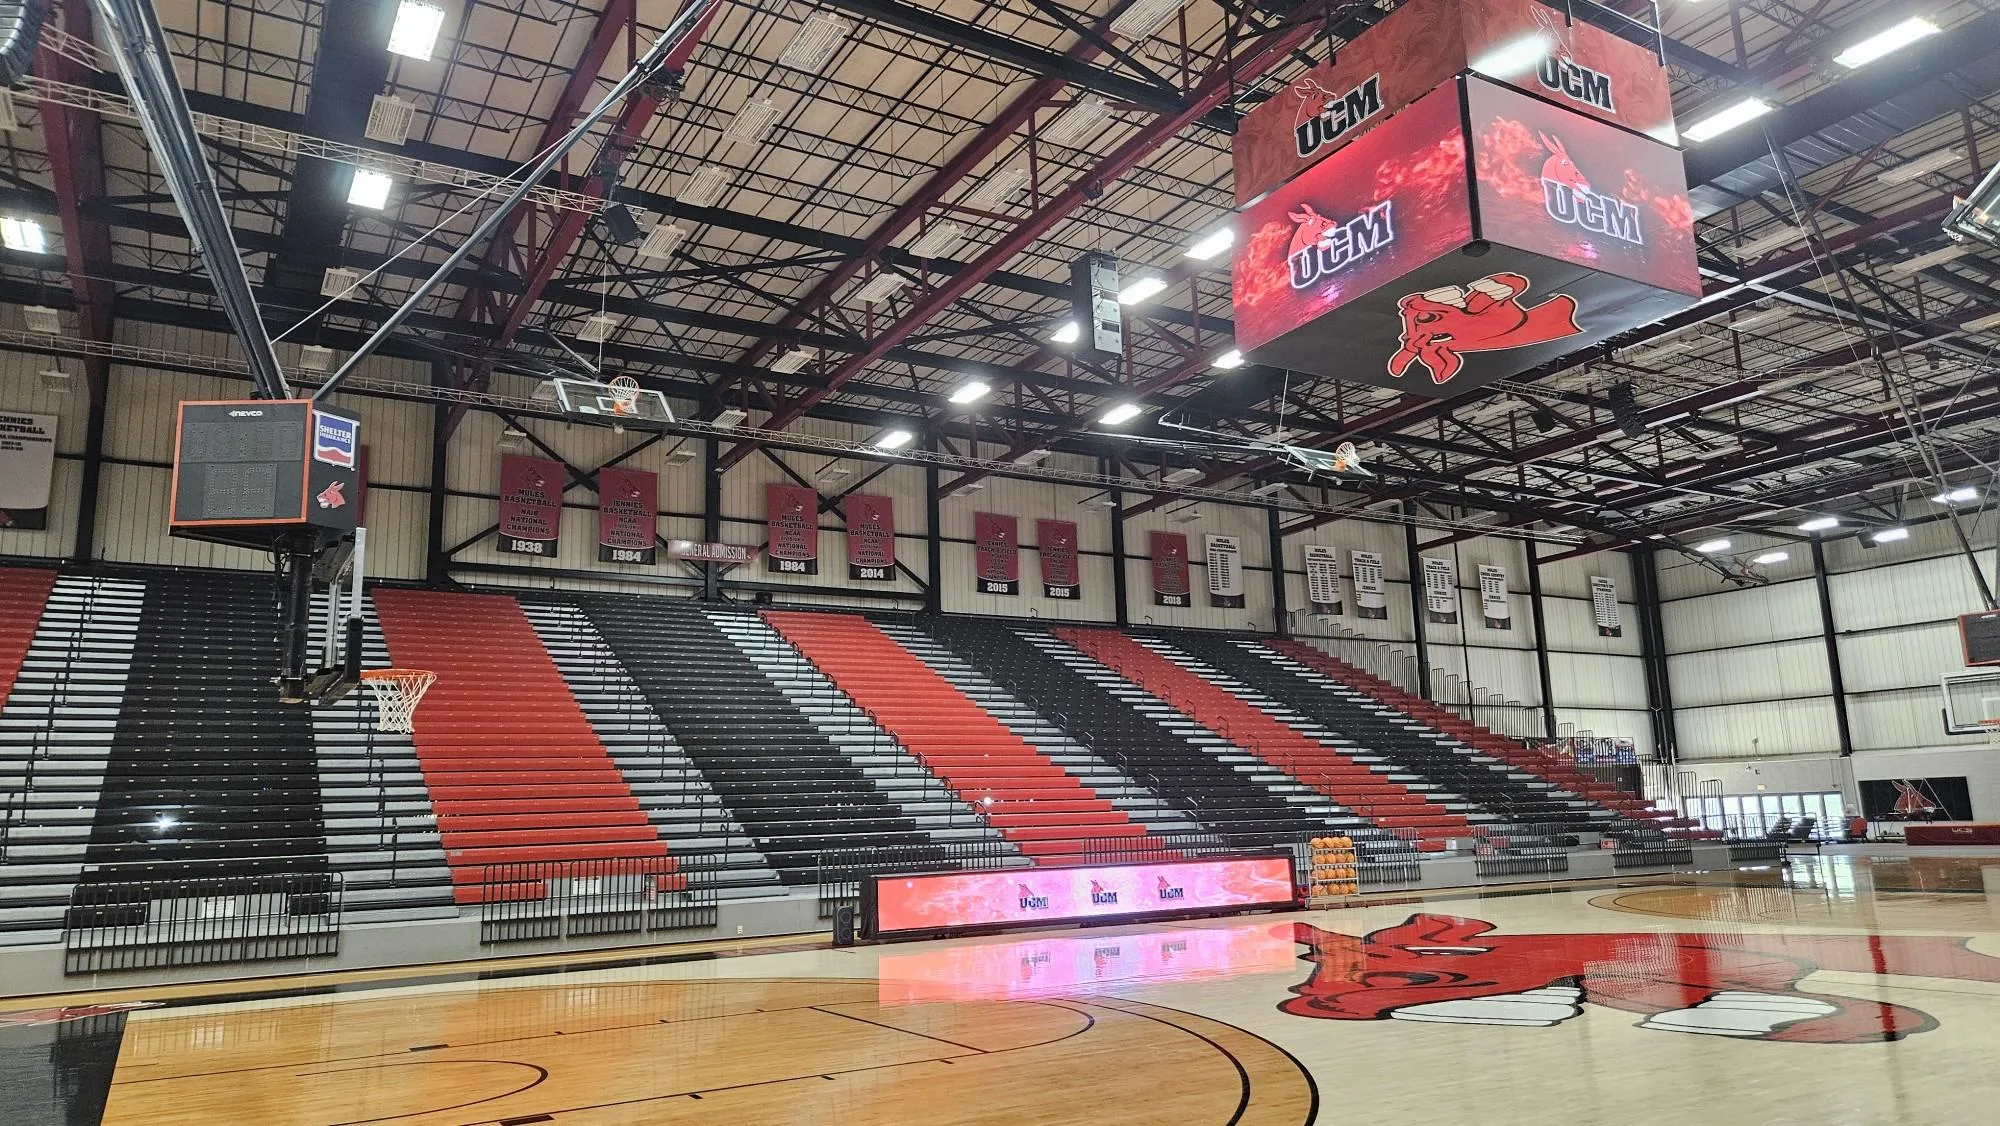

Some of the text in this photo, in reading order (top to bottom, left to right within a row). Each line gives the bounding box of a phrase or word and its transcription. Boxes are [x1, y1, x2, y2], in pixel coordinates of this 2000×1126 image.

[1537, 54, 1615, 113] UCM
[1295, 73, 1384, 158] UCM
[1541, 177, 1643, 244] UCM
[1288, 200, 1393, 289] UCM
[319, 424, 352, 439] SHELTER
[319, 432, 351, 444] INSURANCE
[518, 489, 545, 498] MULES
[504, 496, 558, 507] BASKETBALL
[613, 500, 643, 508] JENNIES
[603, 507, 652, 517] BASKETBALL
[510, 516, 548, 525] NATIONAL
[771, 521, 814, 530] BASKETBALL
[506, 524, 550, 534] CHAMPIONS
[610, 530, 644, 539] NATIONAL
[850, 530, 890, 538] BASKETBALL
[511, 540, 543, 553] 1938
[607, 538, 647, 547] CHAMPIONS
[612, 550, 641, 562] 1984
[681, 543, 746, 560] GENERAL ADMISSION
[780, 560, 806, 572] 1984
[860, 568, 884, 579] 2014
[987, 582, 1009, 593] 2015
[1049, 587, 1070, 598] 2015
[1163, 595, 1182, 605] 2018
[1092, 892, 1118, 904] UCM
[1160, 888, 1184, 899] UCM
[1019, 896, 1048, 909] UCM
